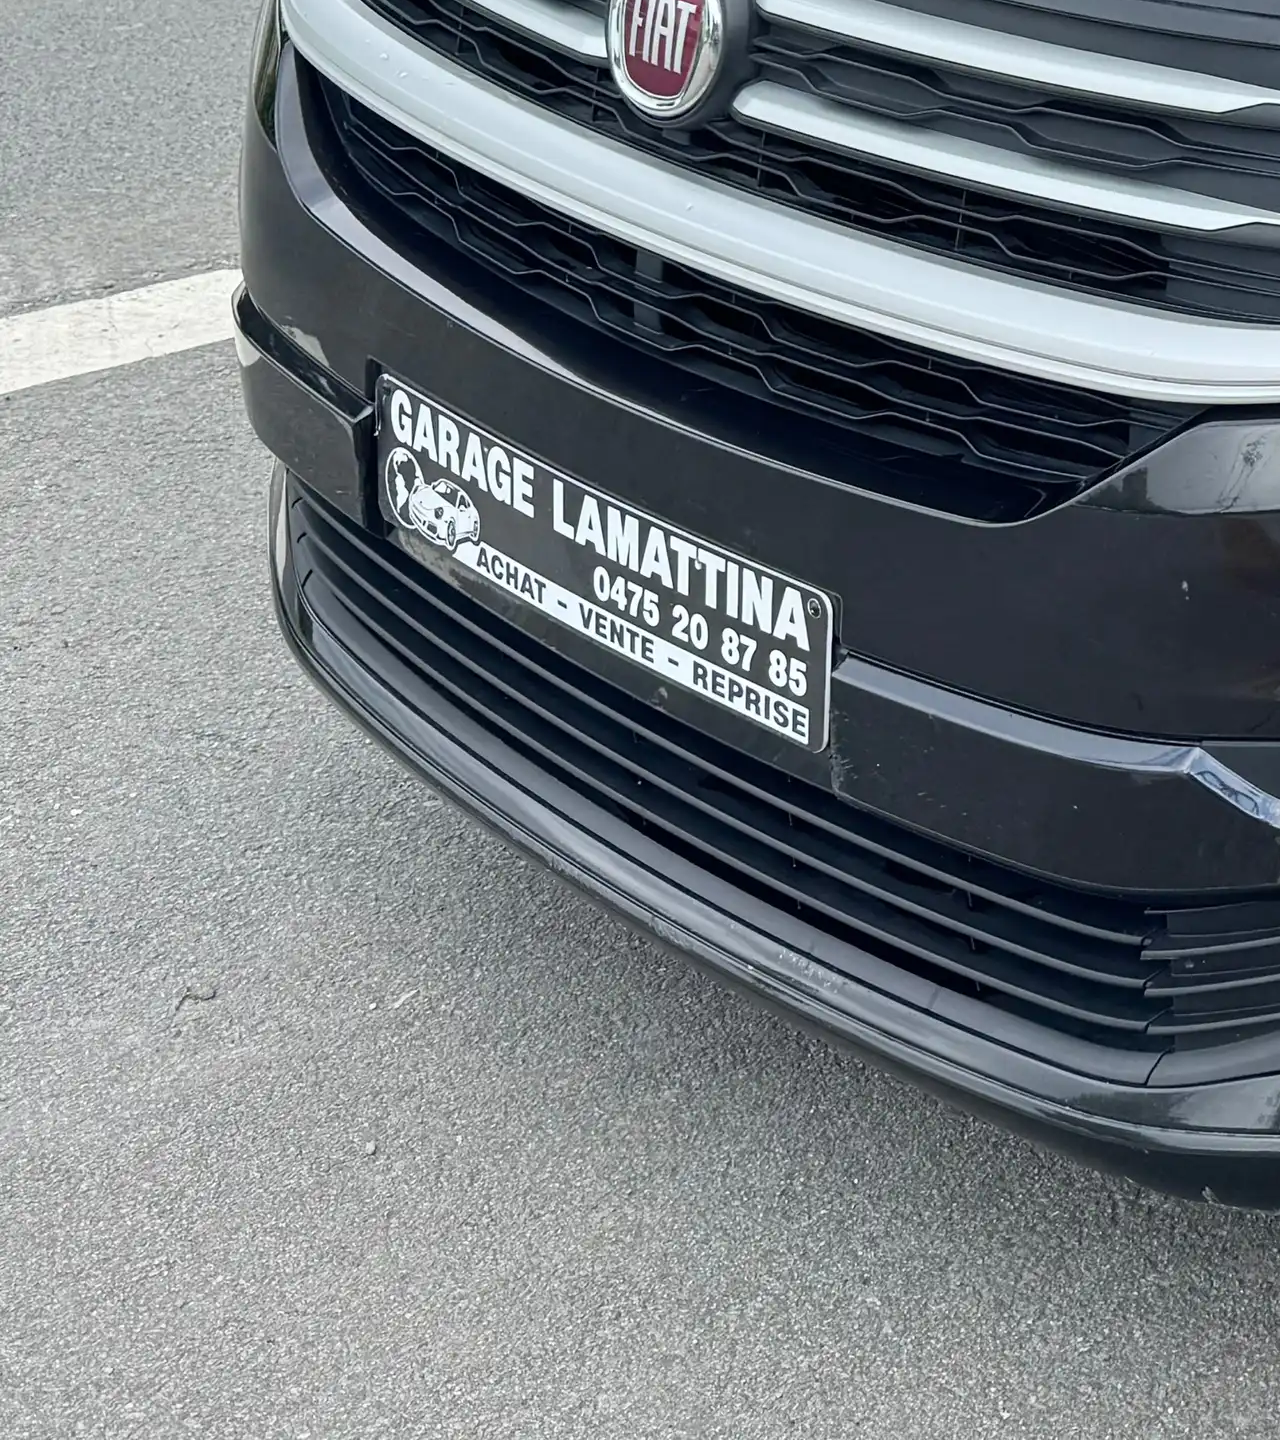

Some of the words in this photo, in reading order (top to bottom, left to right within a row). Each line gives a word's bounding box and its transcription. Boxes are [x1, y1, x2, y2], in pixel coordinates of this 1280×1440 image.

[390, 388, 535, 519] GARAGE
[552, 477, 811, 652] LAMATTINA
[593, 565, 660, 627] 0475
[671, 604, 709, 650] 20
[721, 627, 757, 672] 87
[768, 649, 808, 697] 85
[476, 546, 547, 605] ACHAT
[579, 601, 655, 664] VENTE
[692, 660, 808, 738] REPRISE
